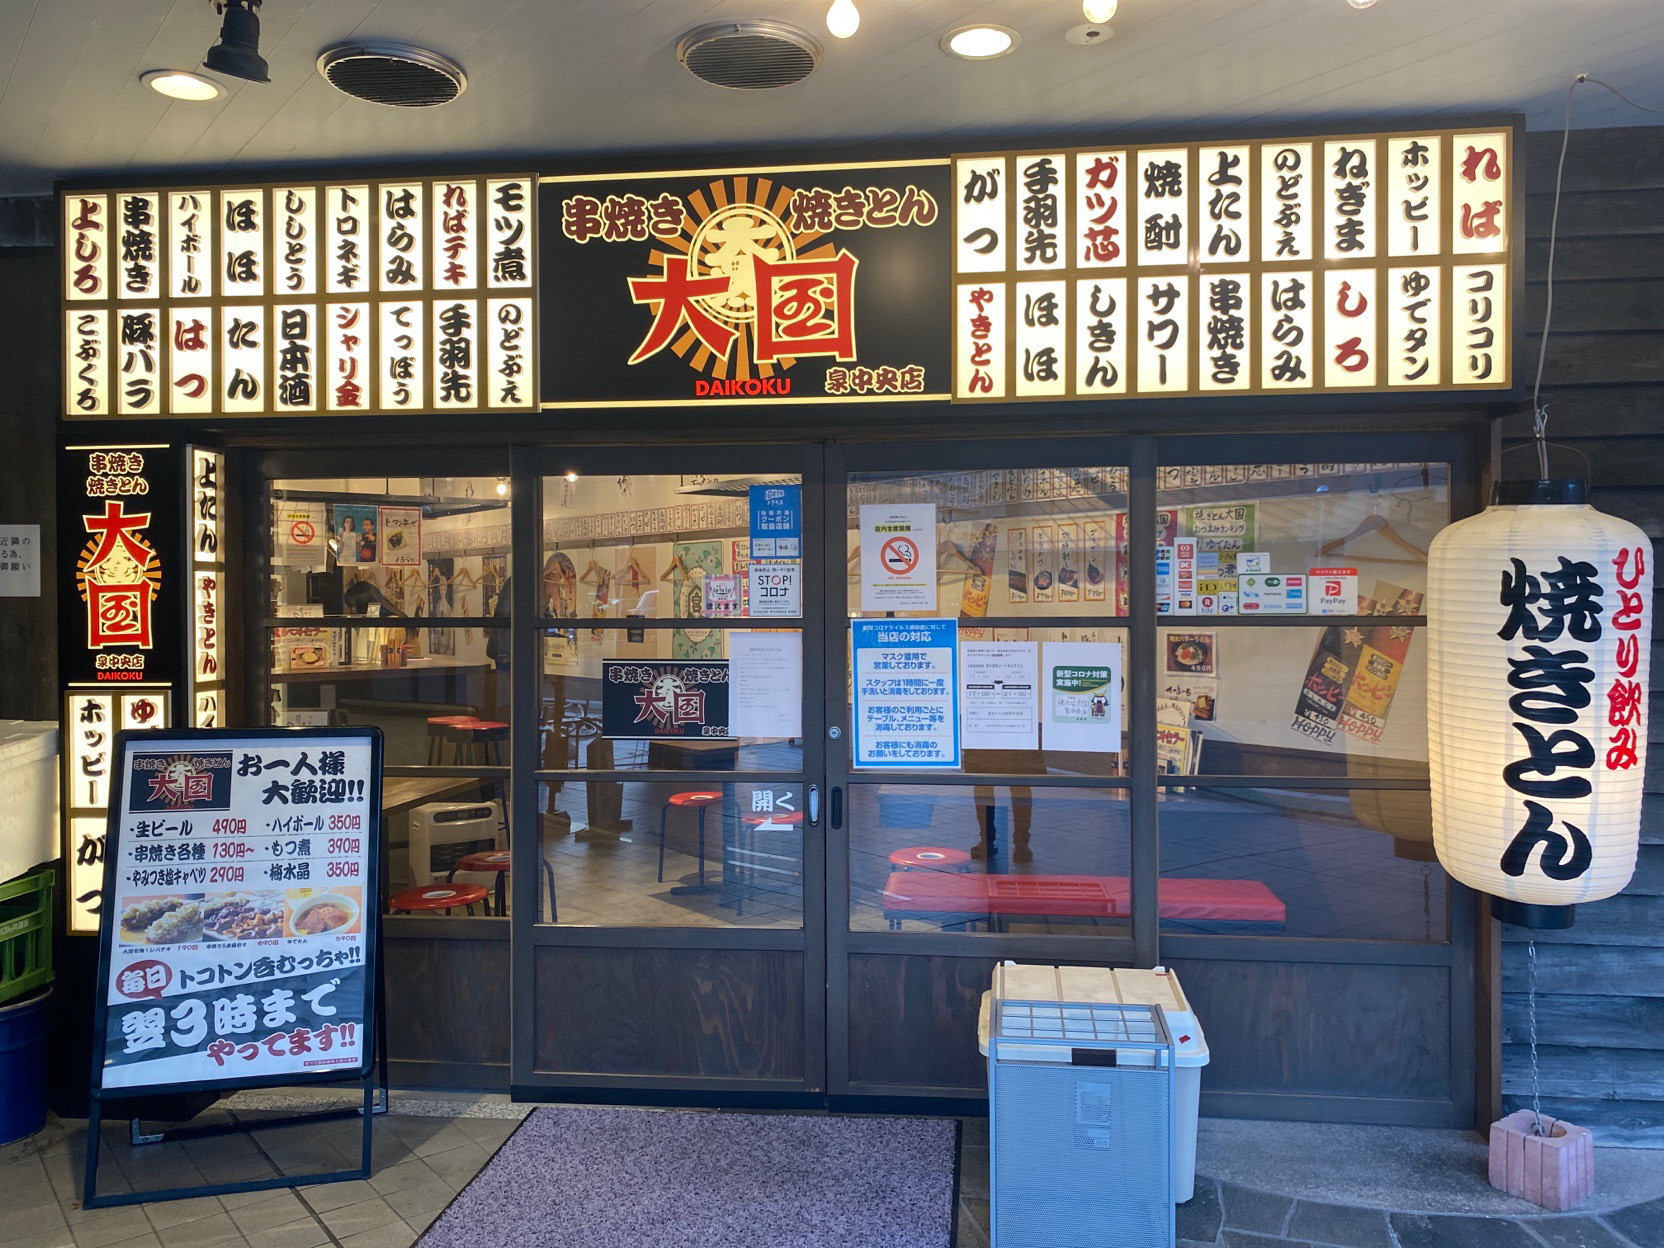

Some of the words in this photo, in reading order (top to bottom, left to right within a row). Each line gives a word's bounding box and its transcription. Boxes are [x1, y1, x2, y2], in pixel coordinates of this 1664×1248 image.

[493, 182, 527, 282] モツ煮
[562, 194, 687, 244] 串焼き
[790, 184, 938, 234] 焼きとん
[963, 170, 1000, 253] がつ
[1023, 158, 1058, 264] 手羽先
[1083, 156, 1120, 262] ガツ芯
[1145, 160, 1182, 252] 焼酎
[1208, 151, 1241, 258] 上たん
[1275, 148, 1301, 258] のどぶえ
[1334, 146, 1369, 252] ねぎま
[1402, 140, 1428, 252] ホッピー
[1460, 146, 1502, 239] れば
[72, 199, 101, 293] 上しろ
[122, 196, 154, 292] 串焼き
[178, 194, 202, 294] ハイボール
[226, 200, 258, 283] ほほ
[285, 189, 306, 290] ししとう
[336, 188, 359, 287] トロネギ
[385, 188, 416, 284] はらみ
[442, 184, 467, 283] ればテキ
[76, 315, 100, 409] こぶくろ
[122, 313, 154, 408] 豚バラ
[174, 319, 207, 398] はつ
[227, 318, 260, 400] たん
[279, 310, 312, 406] 日本酒
[335, 305, 363, 407] シャリ金
[390, 306, 416, 404] てっぽう
[438, 303, 471, 402] 手羽先
[499, 303, 521, 402] のどぶえ
[968, 288, 992, 394] やきとん
[1023, 292, 1057, 383] ほほ
[1084, 285, 1117, 388] しきん
[1146, 283, 1181, 385] サワー
[1206, 279, 1245, 384] 串焼き
[1270, 279, 1306, 382] はらみ
[1335, 282, 1369, 373] しろ
[1403, 272, 1430, 381] ゆでタン
[1467, 271, 1493, 380] コリコリ
[695, 378, 791, 396] DAIKOKU
[825, 365, 925, 394] 泉中央店
[86, 475, 149, 497] 焼きとん
[89, 452, 144, 474] 串焼き
[1195, 508, 1245, 520] 焼きとん大国
[1206, 540, 1240, 549] ゆでたん
[758, 575, 792, 586] STOP!
[760, 587, 789, 597] コロナ
[1200, 582, 1217, 591] iD
[95, 654, 144, 670] 泉中央店
[97, 672, 143, 681] DAIKOKU
[609, 666, 653, 683] 串焼き
[874, 661, 936, 669] 営業しております。
[877, 632, 932, 642] 当店の対応
[1056, 670, 1108, 678] 新型コロナ対策
[1606, 546, 1645, 771] ひとり飲み
[862, 687, 949, 695] 手洗いと消毒をしております。
[866, 679, 944, 687] スタッフは1時間に一度
[867, 706, 944, 714] お客様のご利用ごとに
[867, 715, 945, 723] テーブル、メニュー等を
[1497, 555, 1604, 881] 焼きとん
[79, 698, 104, 804] ホッピー
[134, 758, 167, 770] 串焼き
[237, 751, 346, 777] お一人様
[702, 726, 729, 736] 泉中央
[868, 750, 946, 758] お願いをしております。
[875, 741, 938, 749] お客様にも消毒の
[136, 820, 193, 838] 生ビール
[212, 819, 247, 835] 490円
[262, 779, 365, 806] 大歓迎!!
[272, 815, 324, 832] ハイボール
[328, 814, 361, 830] 350円
[752, 790, 795, 812] 開く
[135, 842, 206, 862] 串焼き各種
[209, 866, 245, 883] 290円
[269, 864, 311, 881] 梅水晶
[326, 861, 360, 878] 350円
[271, 838, 311, 857] もつ煮
[327, 838, 361, 854] 390円
[121, 967, 168, 994] 毎日
[180, 946, 361, 989] トコトン呑むっちゃ!!
[122, 978, 341, 1054] 翌3時まで
[207, 1022, 356, 1067] やってます!!
